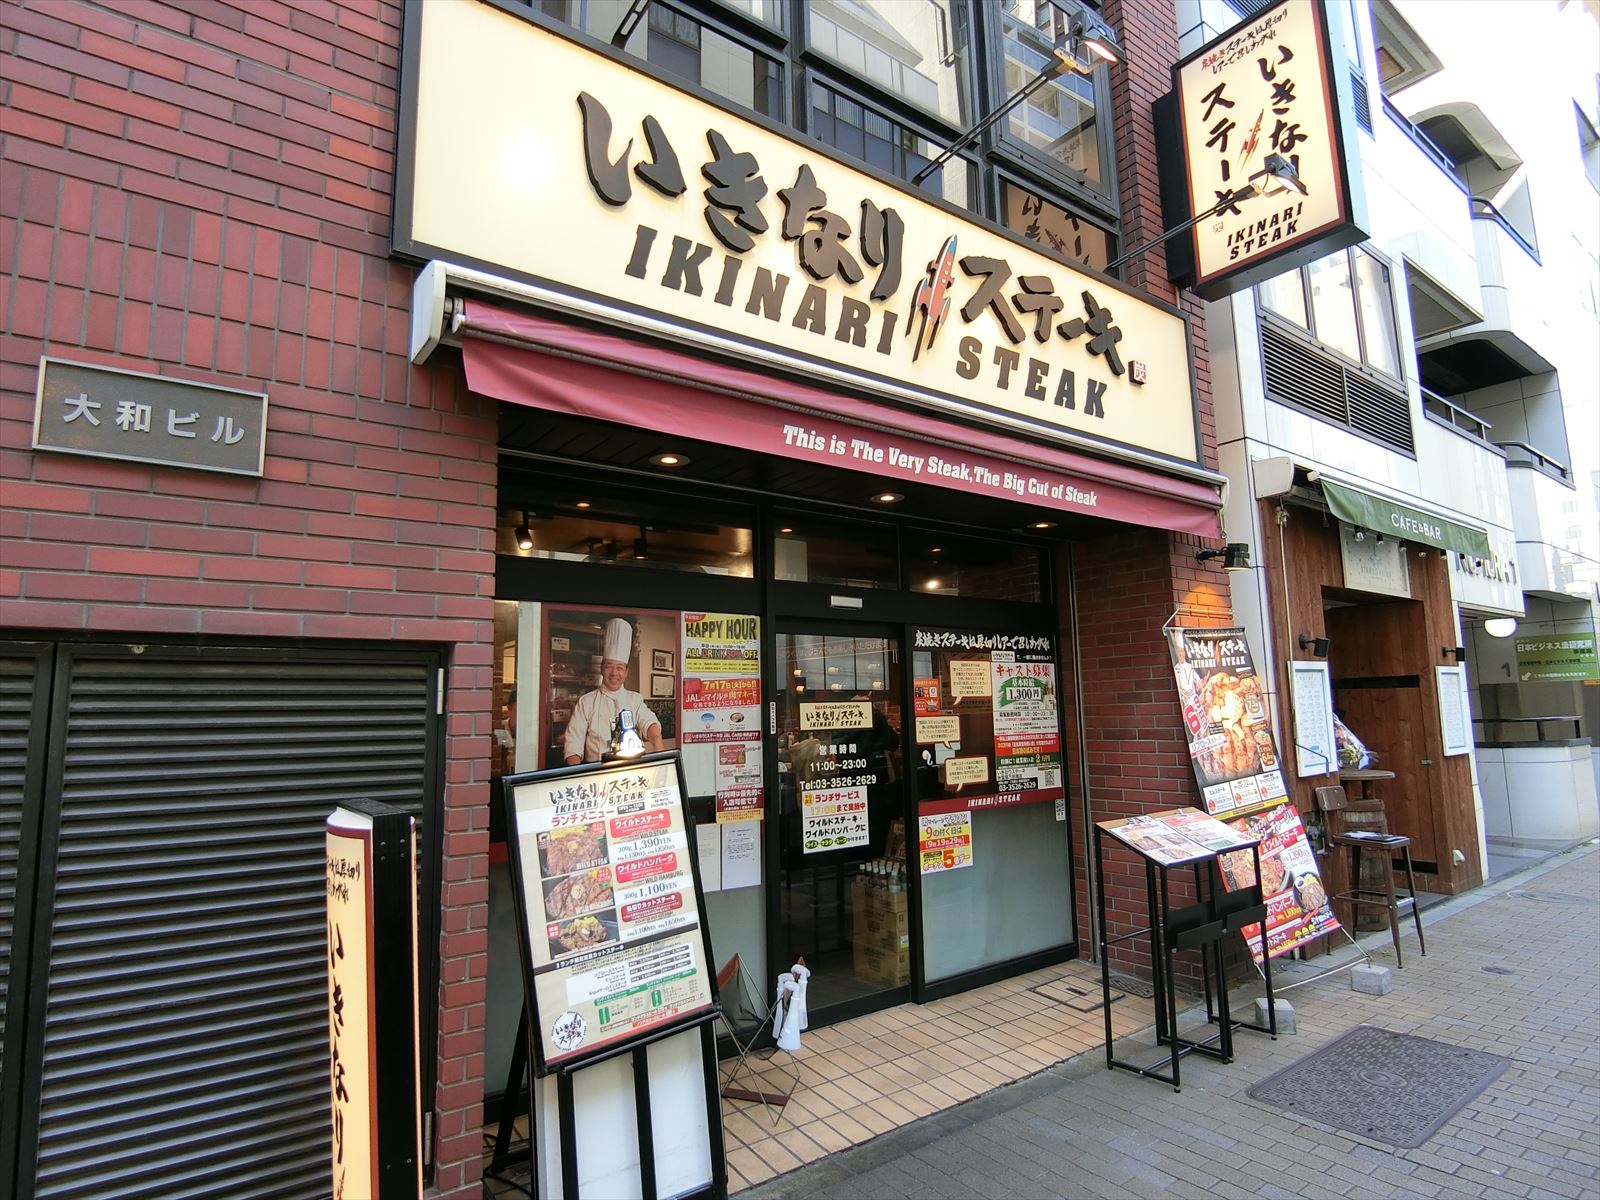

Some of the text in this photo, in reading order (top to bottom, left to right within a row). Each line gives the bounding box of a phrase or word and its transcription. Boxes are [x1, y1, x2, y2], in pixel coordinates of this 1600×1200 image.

[1201, 82, 1242, 217] ステーキ
[1227, 201, 1303, 247] IKINARI
[577, 91, 1126, 376] いきなり ステーキ
[1230, 219, 1298, 260] STEAK
[625, 225, 1107, 418] IKINARI STEAK
[63, 393, 245, 445] 大和ビル
[783, 424, 825, 451] This
[829, 434, 847, 456] is
[850, 438, 884, 463] The
[887, 447, 925, 475] Very
[1003, 472, 1026, 496] Big
[1027, 477, 1050, 498] Cut
[1051, 483, 1064, 500] of
[1065, 486, 1099, 508] Steak
[686, 618, 757, 640] HAPPY HOUR
[997, 664, 1050, 677] キャスト募集
[1009, 688, 1040, 700] 1,300円
[806, 710, 864, 721] いきなり ステーキ
[819, 744, 857, 755] 営業時間
[549, 776, 648, 804] いきなり ステーキ
[799, 774, 878, 791] Tel:03-3526-2629
[555, 791, 644, 814] IKINARI STEAK
[815, 791, 861, 804] ランチサービス
[998, 793, 1021, 804] STEAK
[551, 810, 615, 827] ランチメニュー
[615, 813, 665, 829] ワイルドステーキ
[805, 824, 867, 839] ワイルドハンバーグに
[925, 826, 962, 840] 9の付く日は
